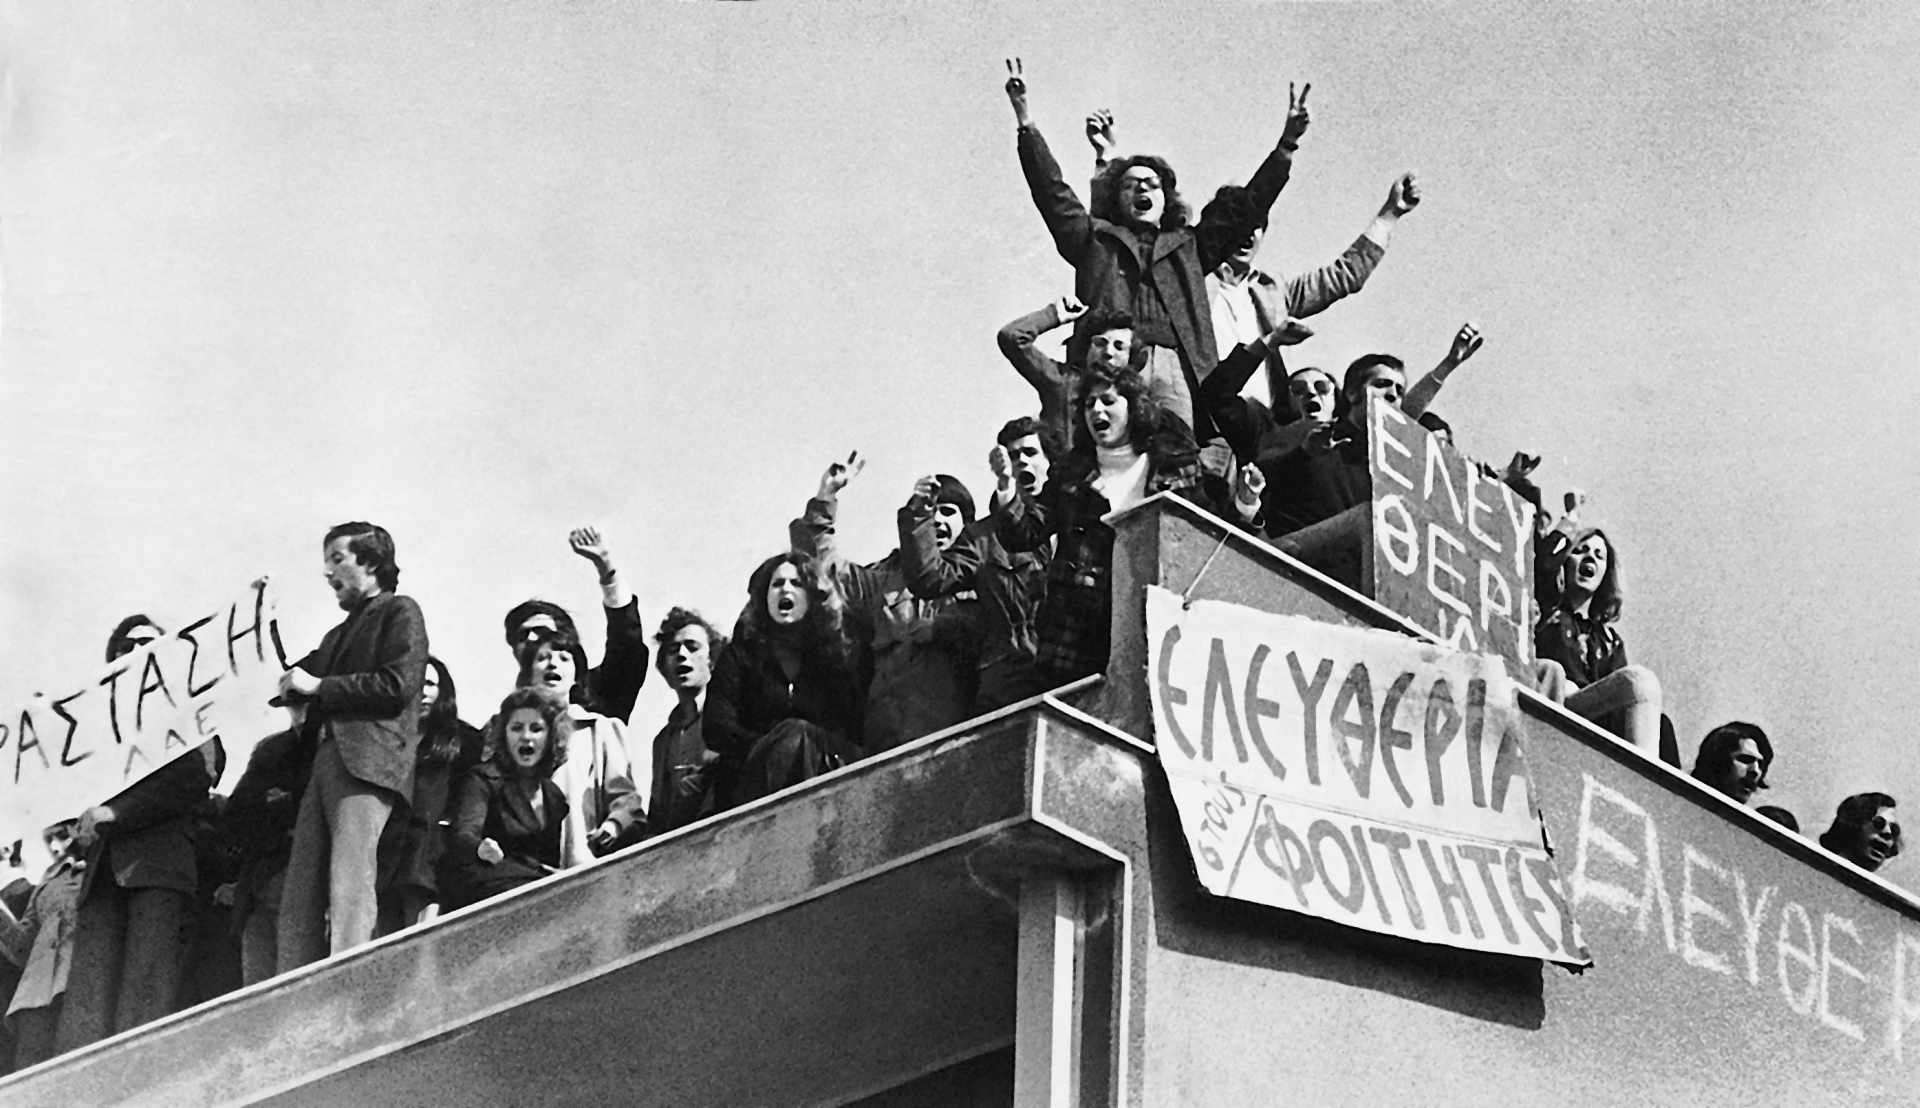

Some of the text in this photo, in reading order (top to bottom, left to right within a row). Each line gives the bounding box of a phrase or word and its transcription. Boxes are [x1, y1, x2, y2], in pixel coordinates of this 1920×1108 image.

[1375, 398, 1535, 580] ΕΛΕΥ
[1158, 624, 1538, 819] ΕΛΕΥΘΕΡΙΑ
[1254, 804, 1588, 960] ΦΟΙΤΗΤΕΣ
